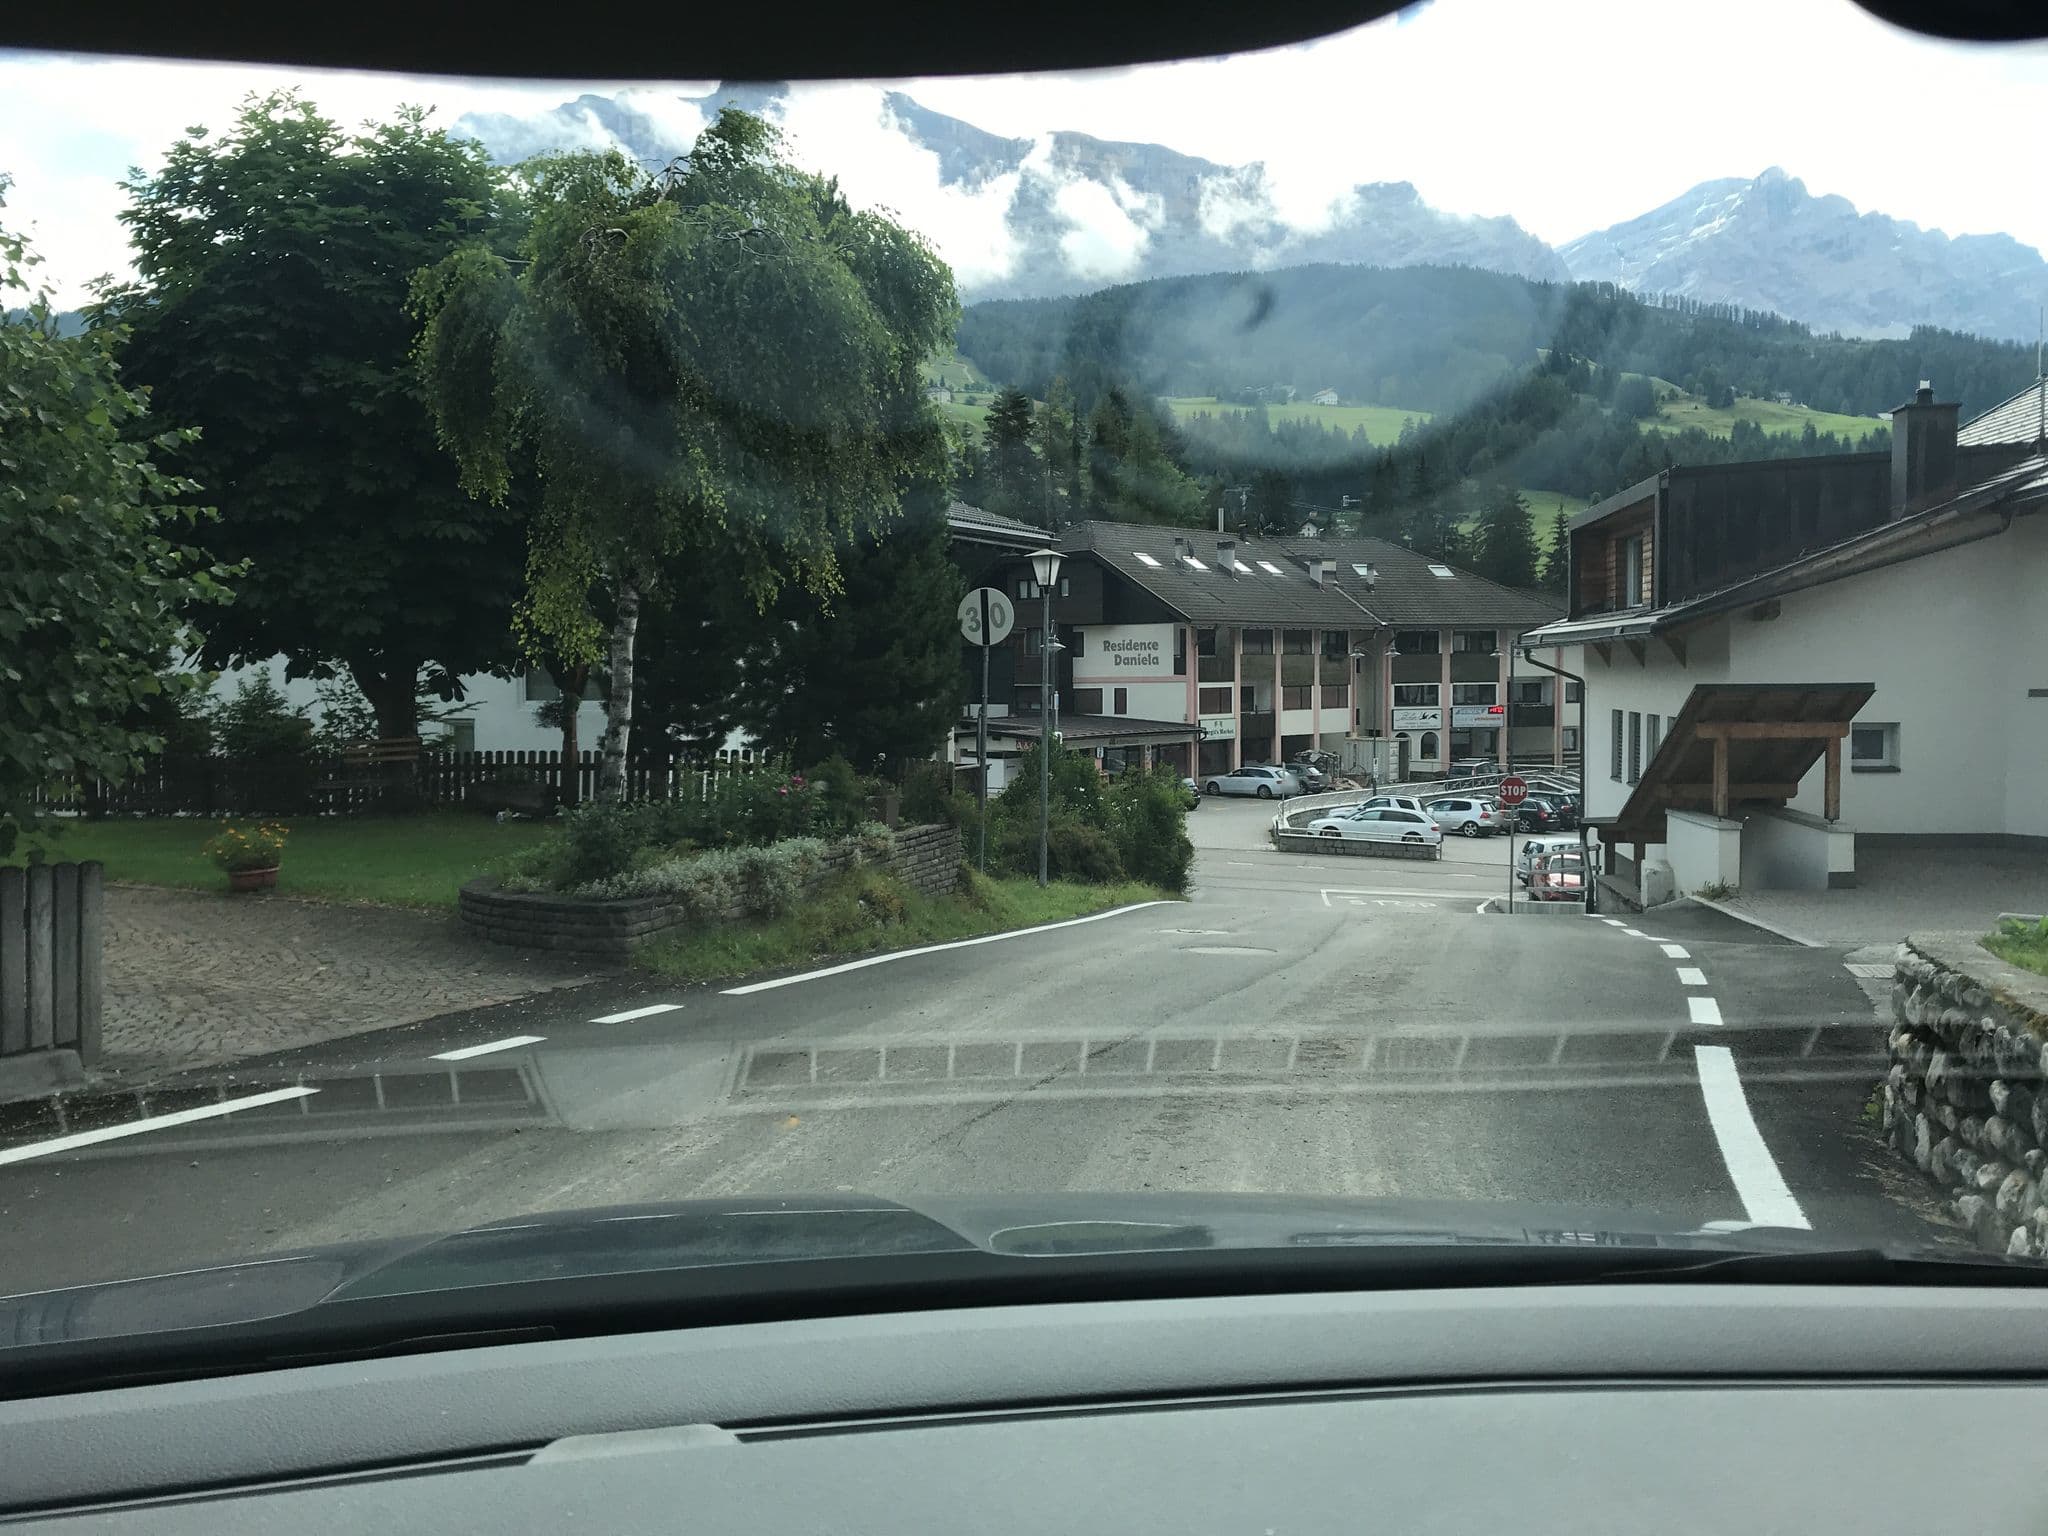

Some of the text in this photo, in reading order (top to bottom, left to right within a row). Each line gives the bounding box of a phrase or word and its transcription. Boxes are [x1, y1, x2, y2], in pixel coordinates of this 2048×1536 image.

[966, 603, 1005, 632] 30
[1103, 640, 1159, 652] Residence
[1114, 654, 1159, 666] Daniela
[1500, 785, 1526, 796] STOP
